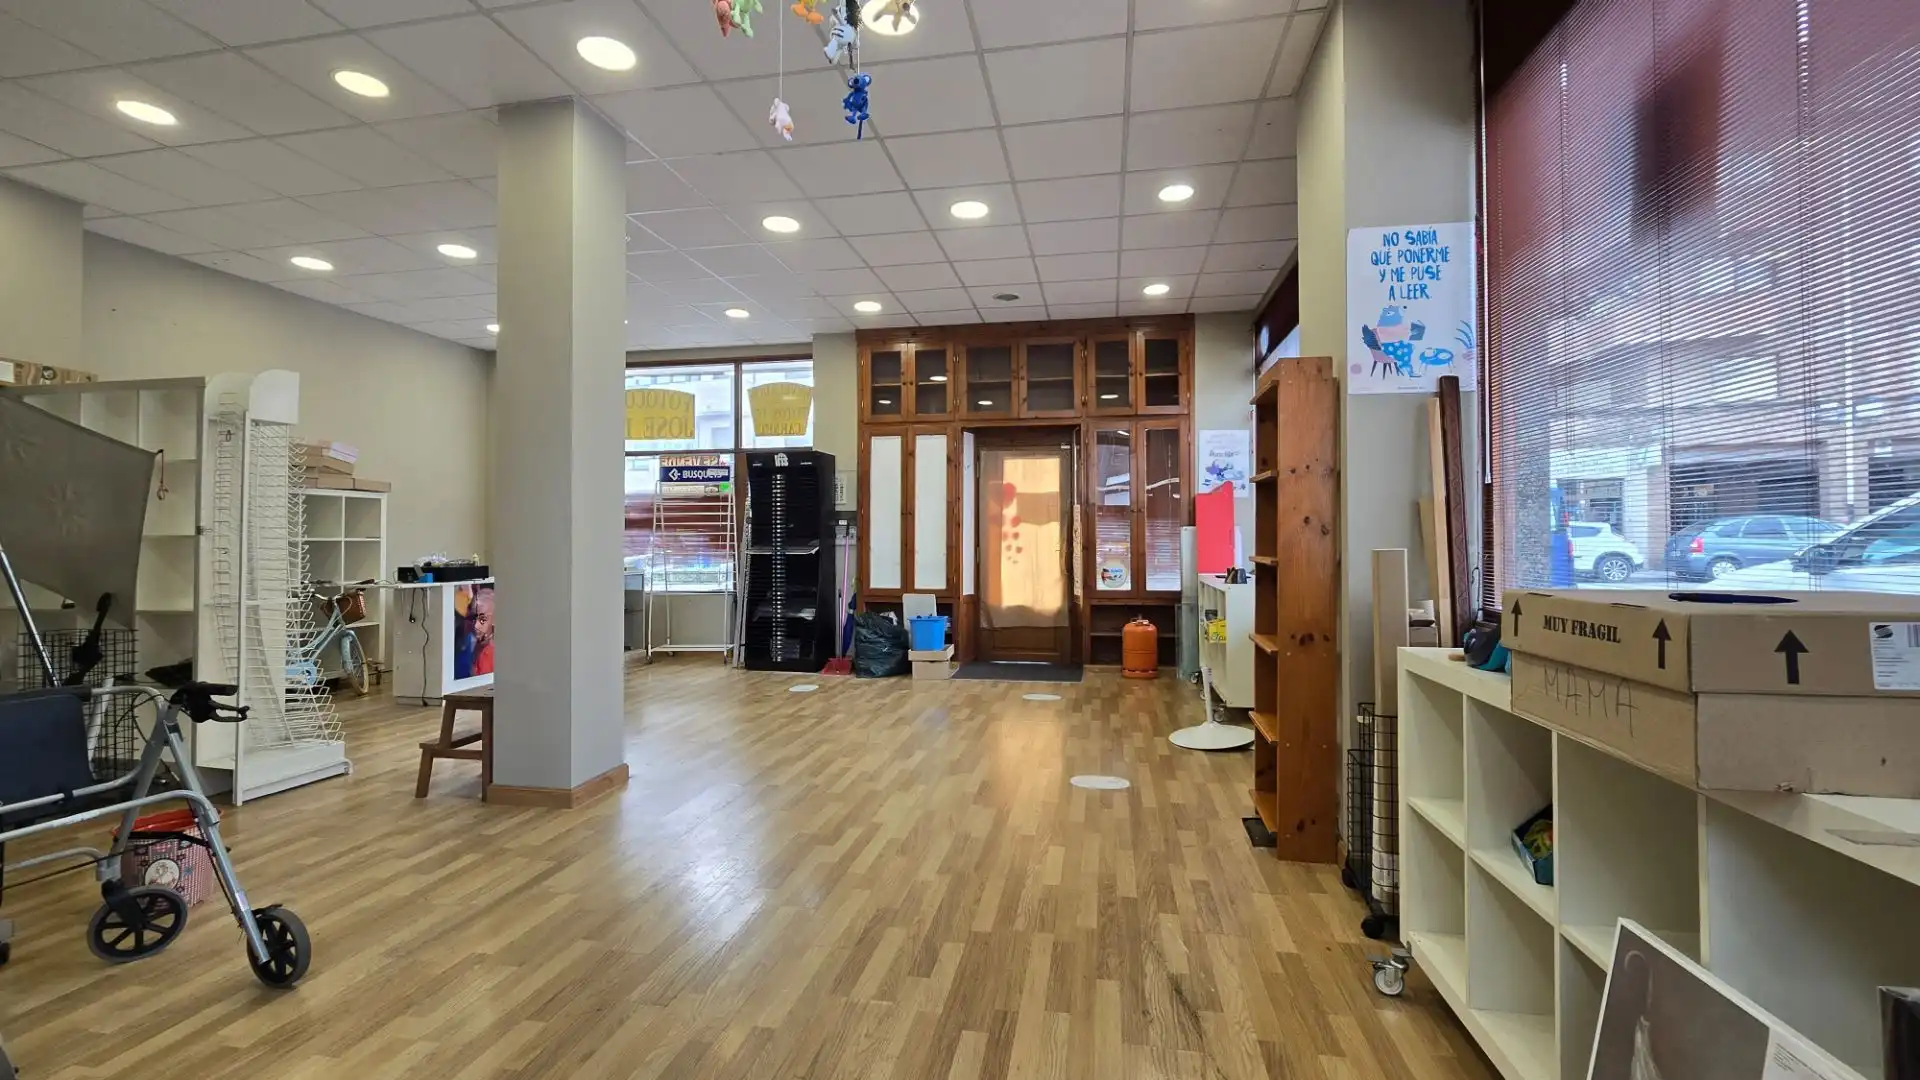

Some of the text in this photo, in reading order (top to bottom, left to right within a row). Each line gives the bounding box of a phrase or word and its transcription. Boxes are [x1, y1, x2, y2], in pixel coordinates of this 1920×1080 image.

[1383, 225, 1438, 247] NO SABÍA
[1370, 245, 1451, 266] QUÉ PONERME
[1379, 264, 1443, 283] Y ME PUSE
[1388, 284, 1396, 302] A
[1543, 615, 1621, 643] MUY FRAGIL
[1543, 664, 1641, 738] MAMA
